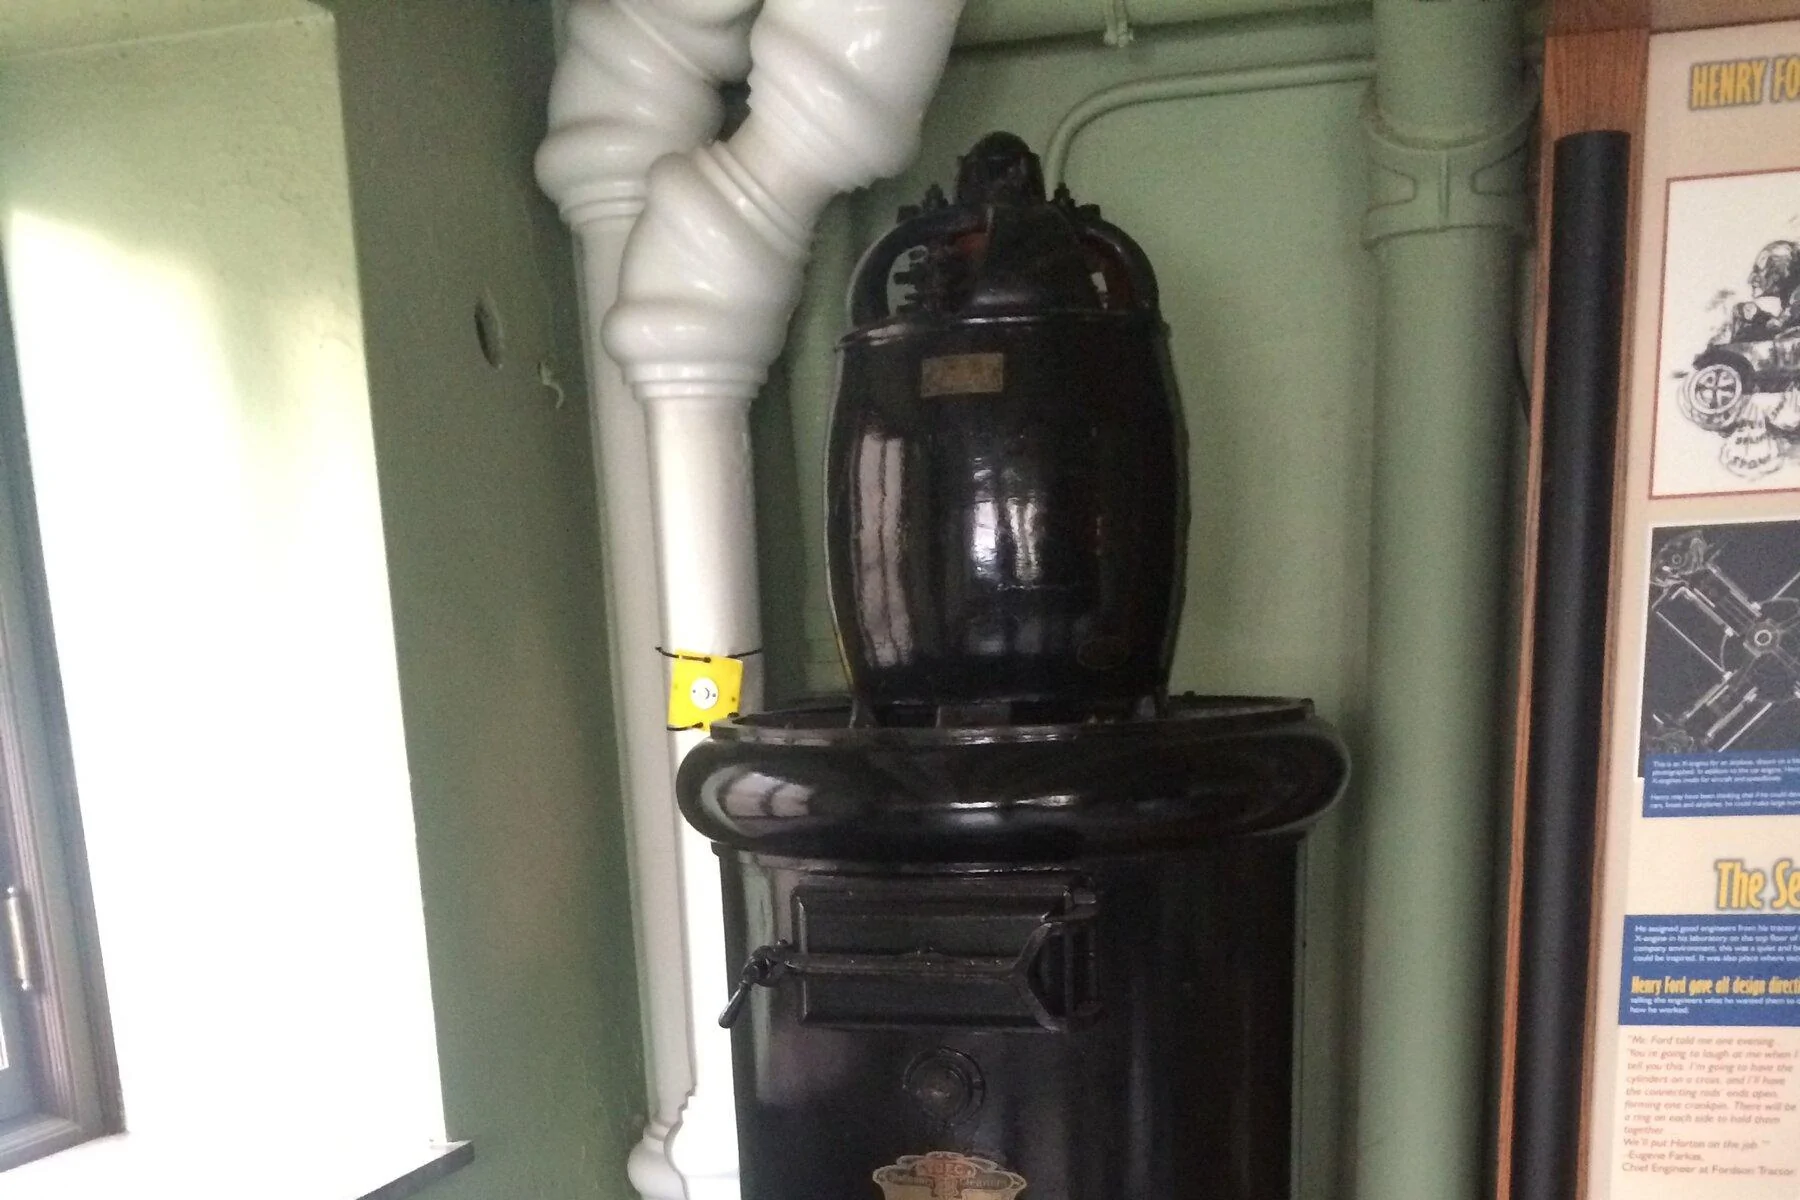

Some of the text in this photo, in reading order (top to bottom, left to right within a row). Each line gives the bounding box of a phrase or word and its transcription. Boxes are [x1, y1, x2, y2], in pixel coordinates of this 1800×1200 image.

[1690, 54, 1800, 109] HENRY FO
[1716, 858, 1800, 909] The Se
[1632, 976, 1662, 996] Henry
[1664, 976, 1686, 994] Ford
[1689, 979, 1714, 996] gave
[1732, 976, 1766, 996] design
[1651, 1035, 1674, 1044] Ford
[1652, 1163, 1696, 1174] Engineer
